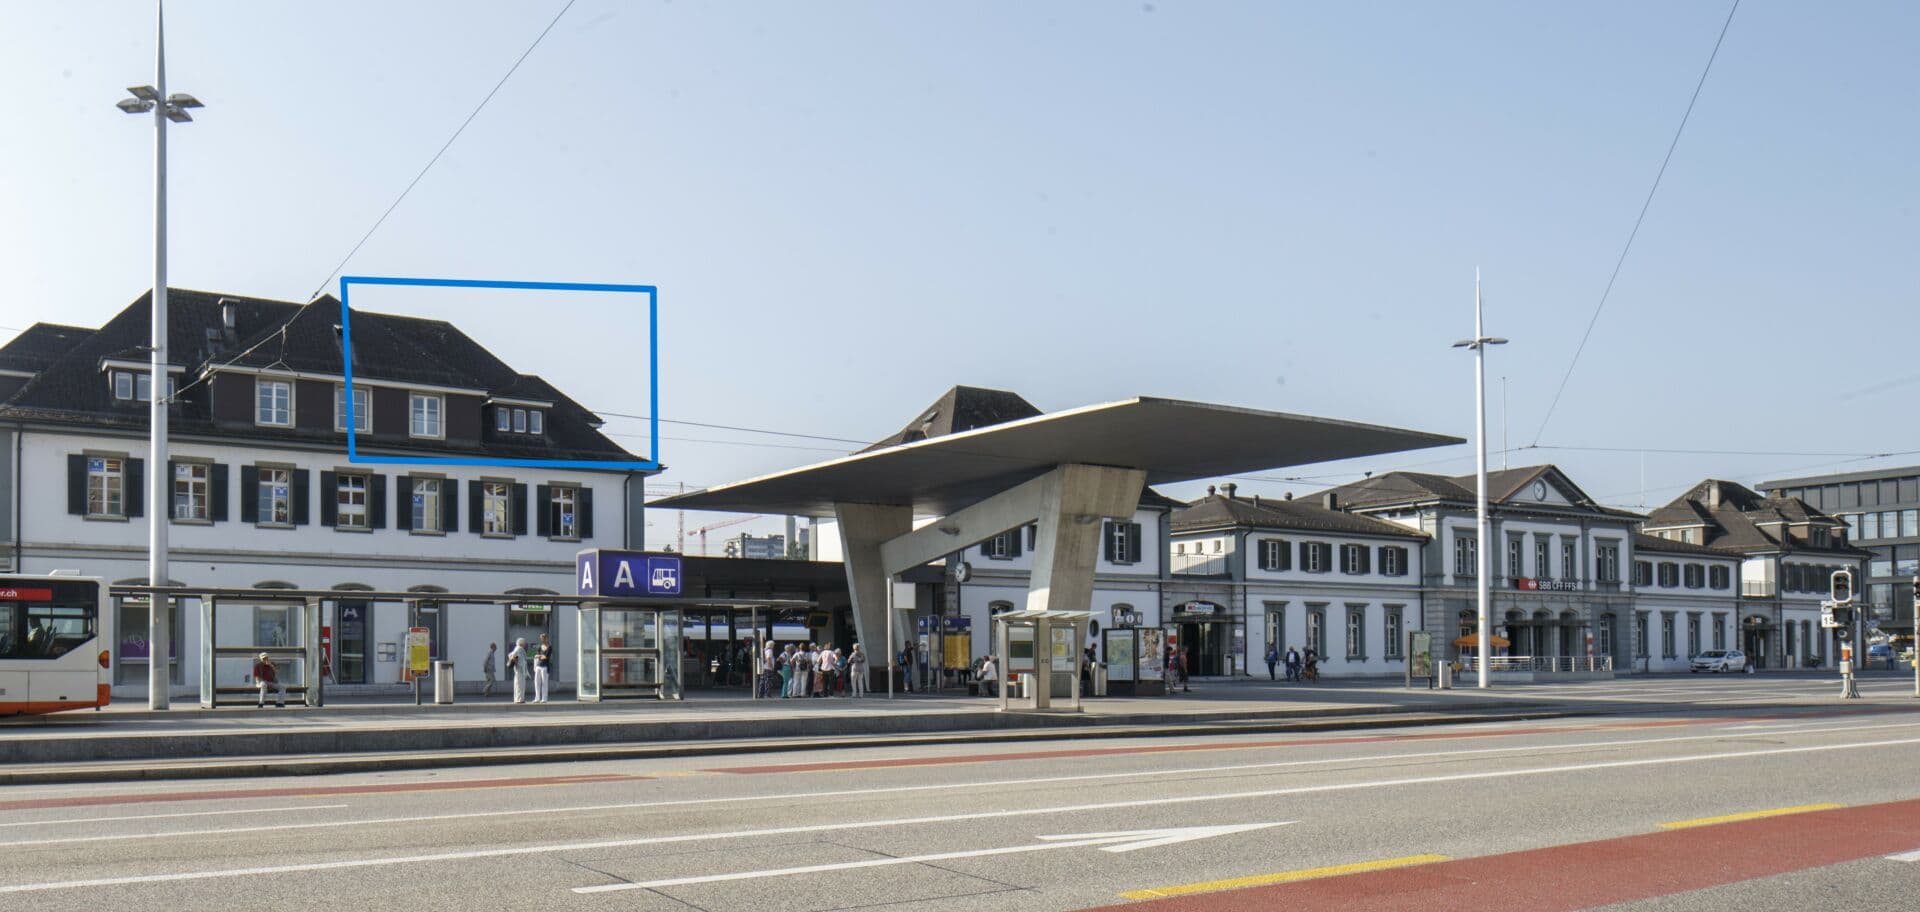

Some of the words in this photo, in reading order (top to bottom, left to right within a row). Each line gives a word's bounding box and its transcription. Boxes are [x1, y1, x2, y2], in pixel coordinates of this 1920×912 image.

[582, 561, 593, 589] A
[614, 560, 635, 588] A
[0, 589, 17, 597] r.ch
[1538, 581, 1551, 590] SBB
[1552, 581, 1563, 590] CFF
[1564, 581, 1576, 591] FFS
